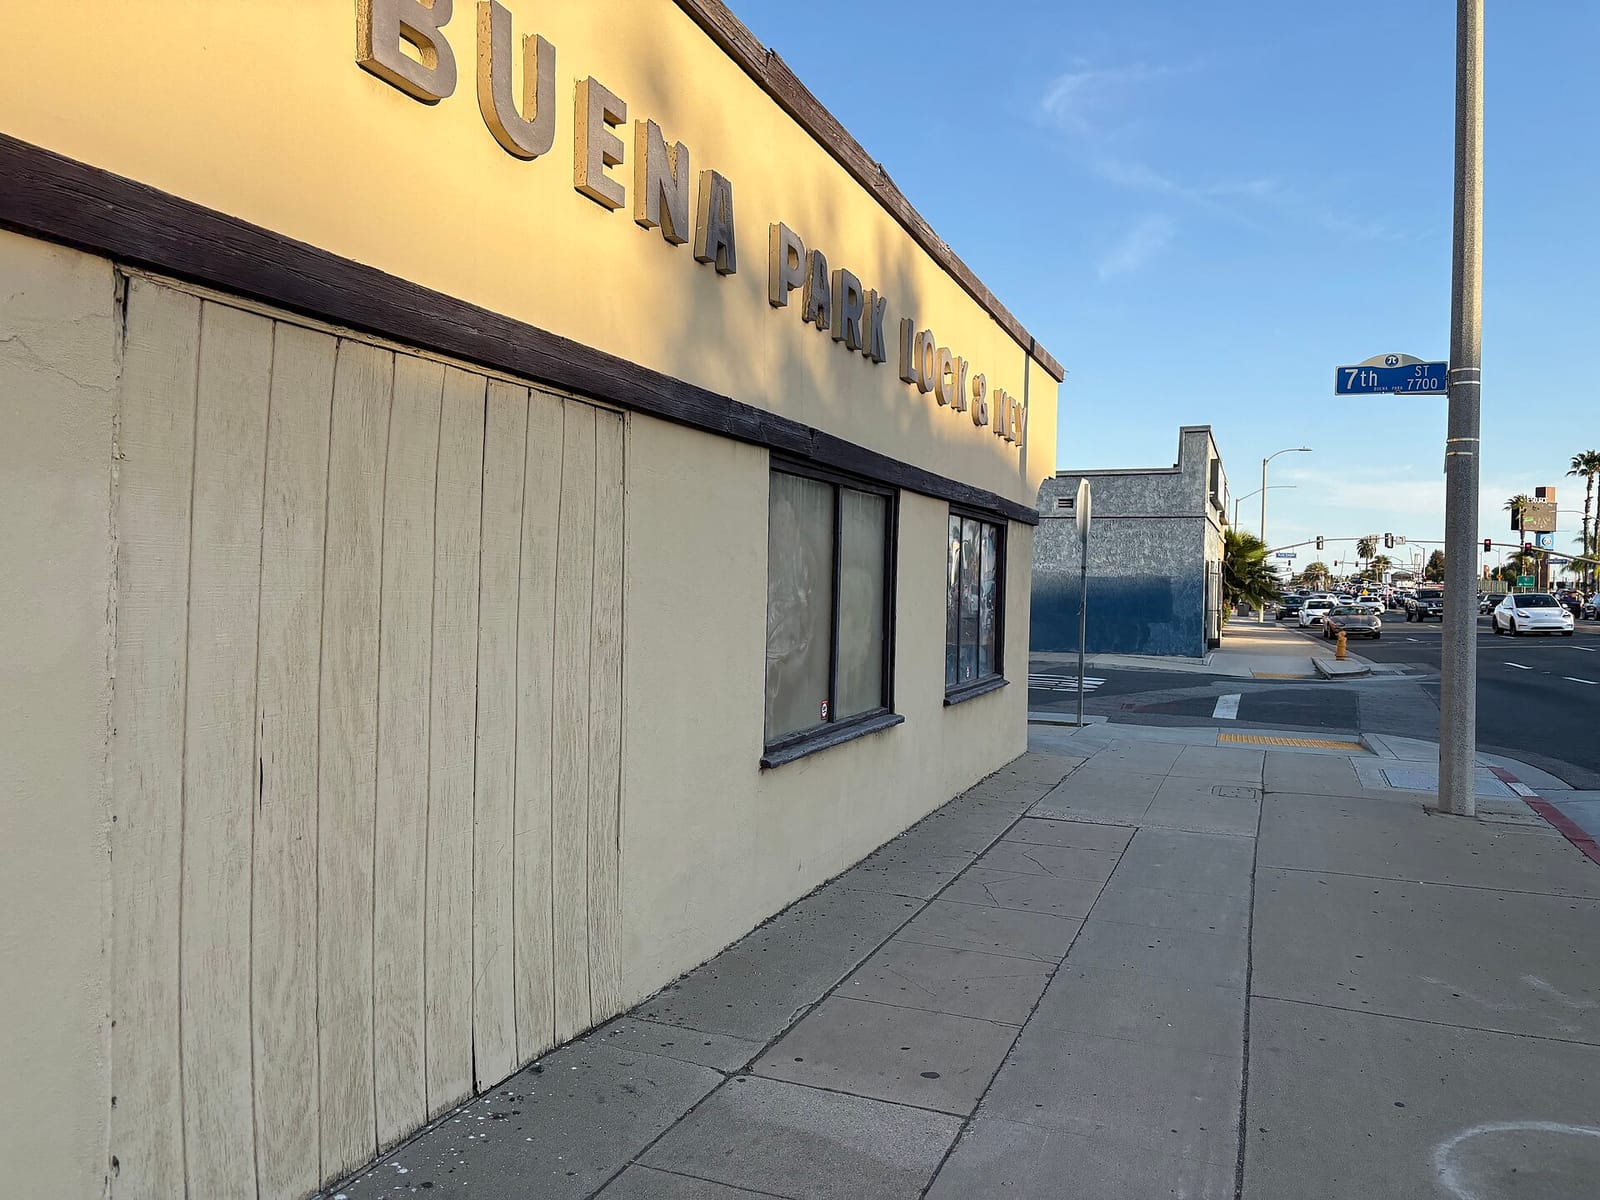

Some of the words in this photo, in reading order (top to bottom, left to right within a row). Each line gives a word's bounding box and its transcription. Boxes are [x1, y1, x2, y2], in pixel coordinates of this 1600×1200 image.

[356, 0, 737, 276] BUENA
[769, 222, 887, 364] PARK
[899, 318, 968, 412] LOCK
[972, 373, 988, 426] &
[993, 388, 1026, 447] KEY
[1345, 368, 1377, 389] 7th
[1415, 365, 1430, 377] ST
[1407, 378, 1438, 390] 7700
